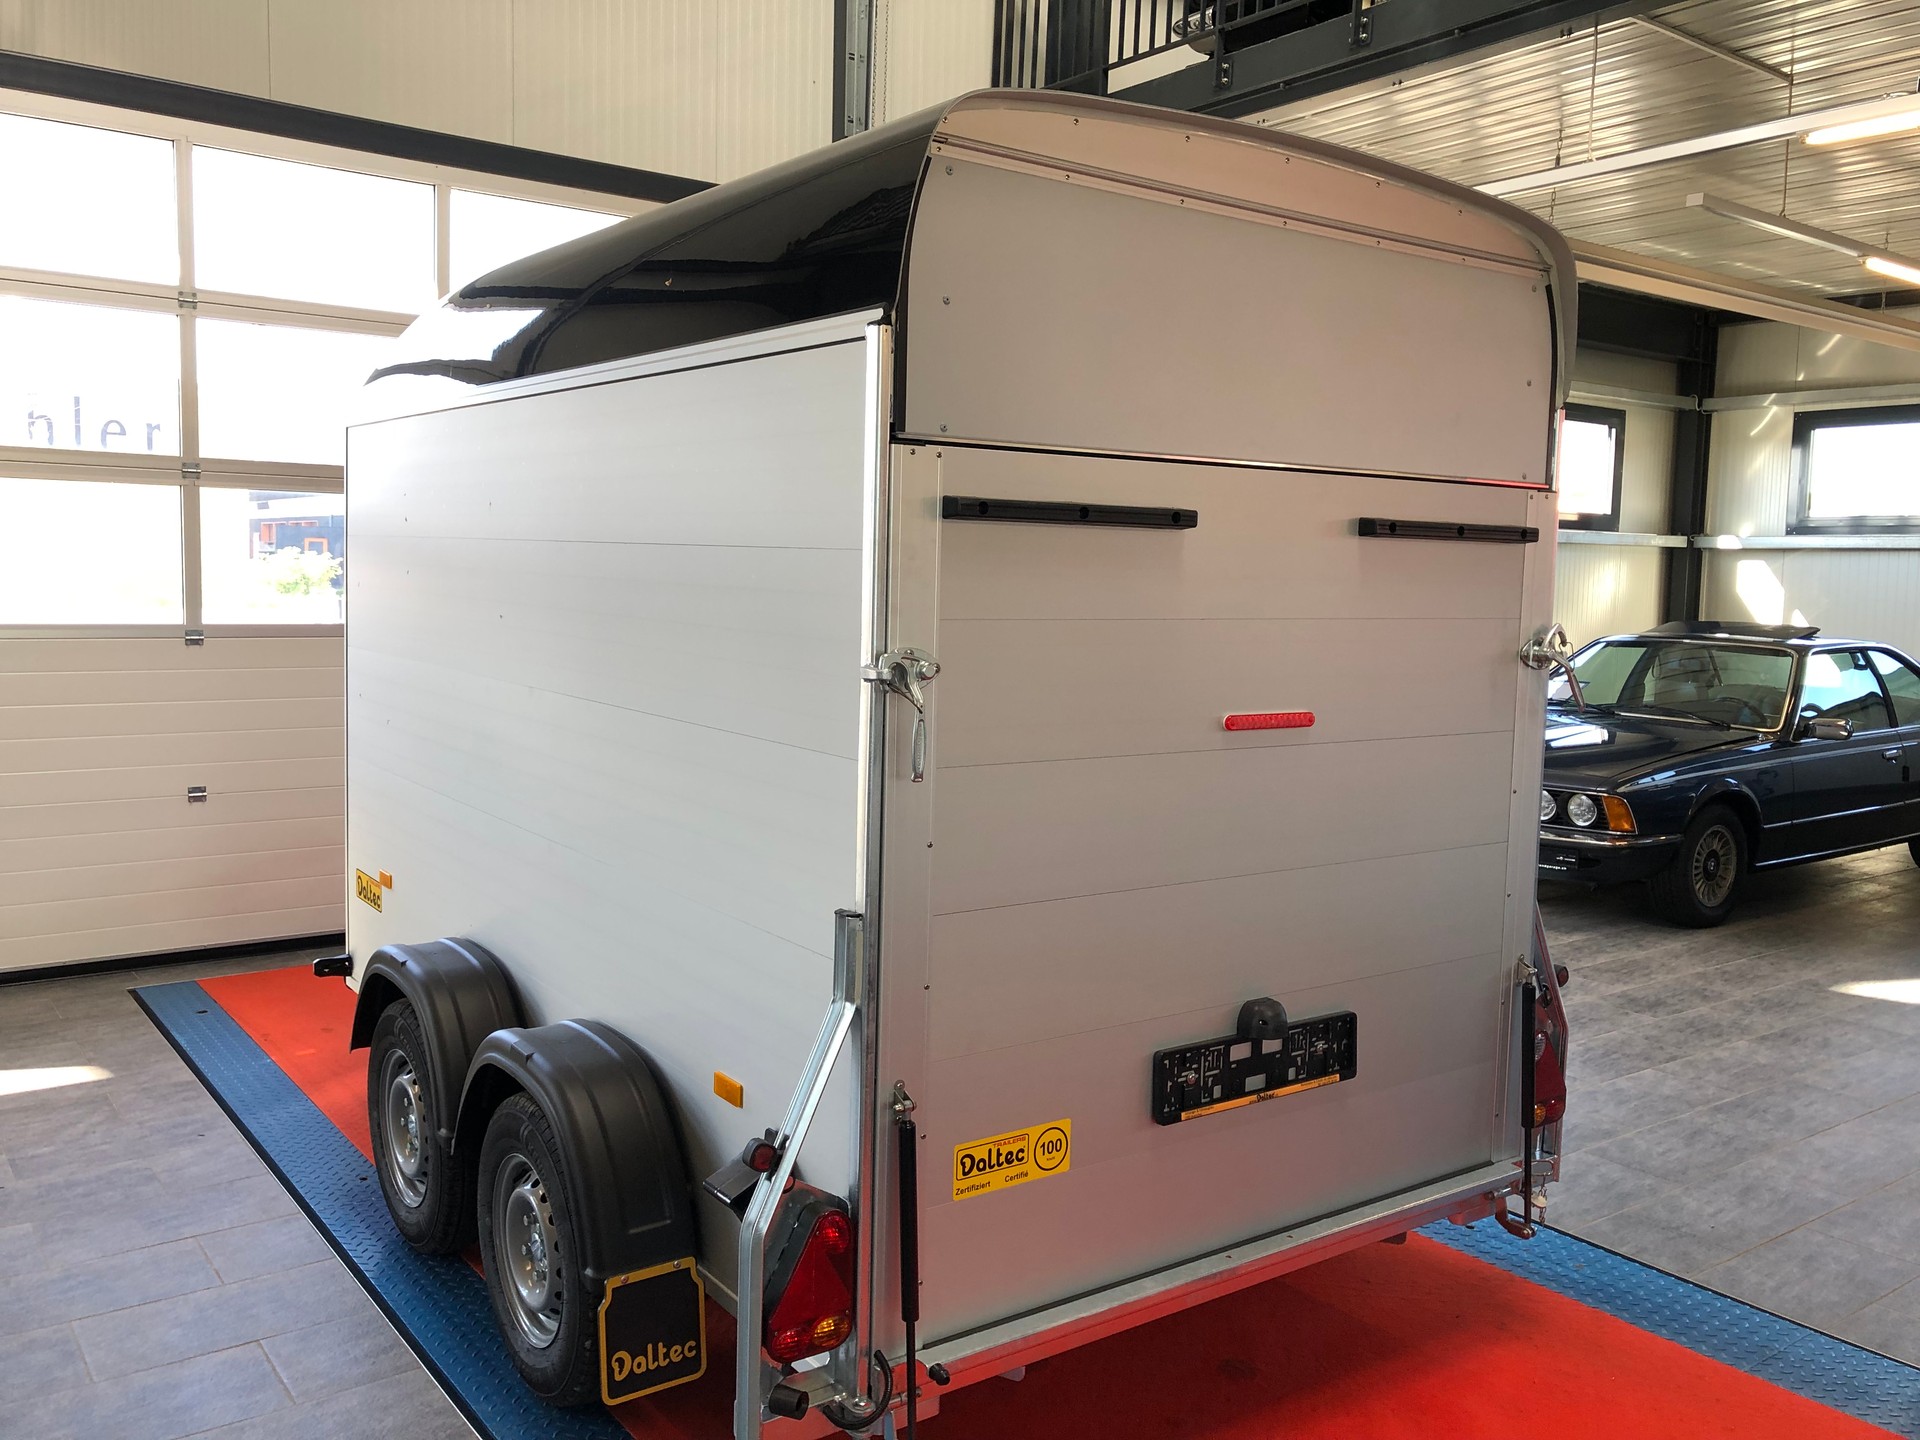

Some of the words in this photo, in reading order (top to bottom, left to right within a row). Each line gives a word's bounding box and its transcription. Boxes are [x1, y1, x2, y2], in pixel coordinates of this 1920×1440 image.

[357, 875, 381, 909] Daltec
[993, 1135, 1027, 1148] TRAILERS
[1039, 1138, 1063, 1157] 100
[960, 1146, 1026, 1177] Daltec
[955, 1181, 991, 1196] Zertifiziert
[1004, 1170, 1029, 1183] Certifié
[611, 1340, 697, 1382] Daltec
